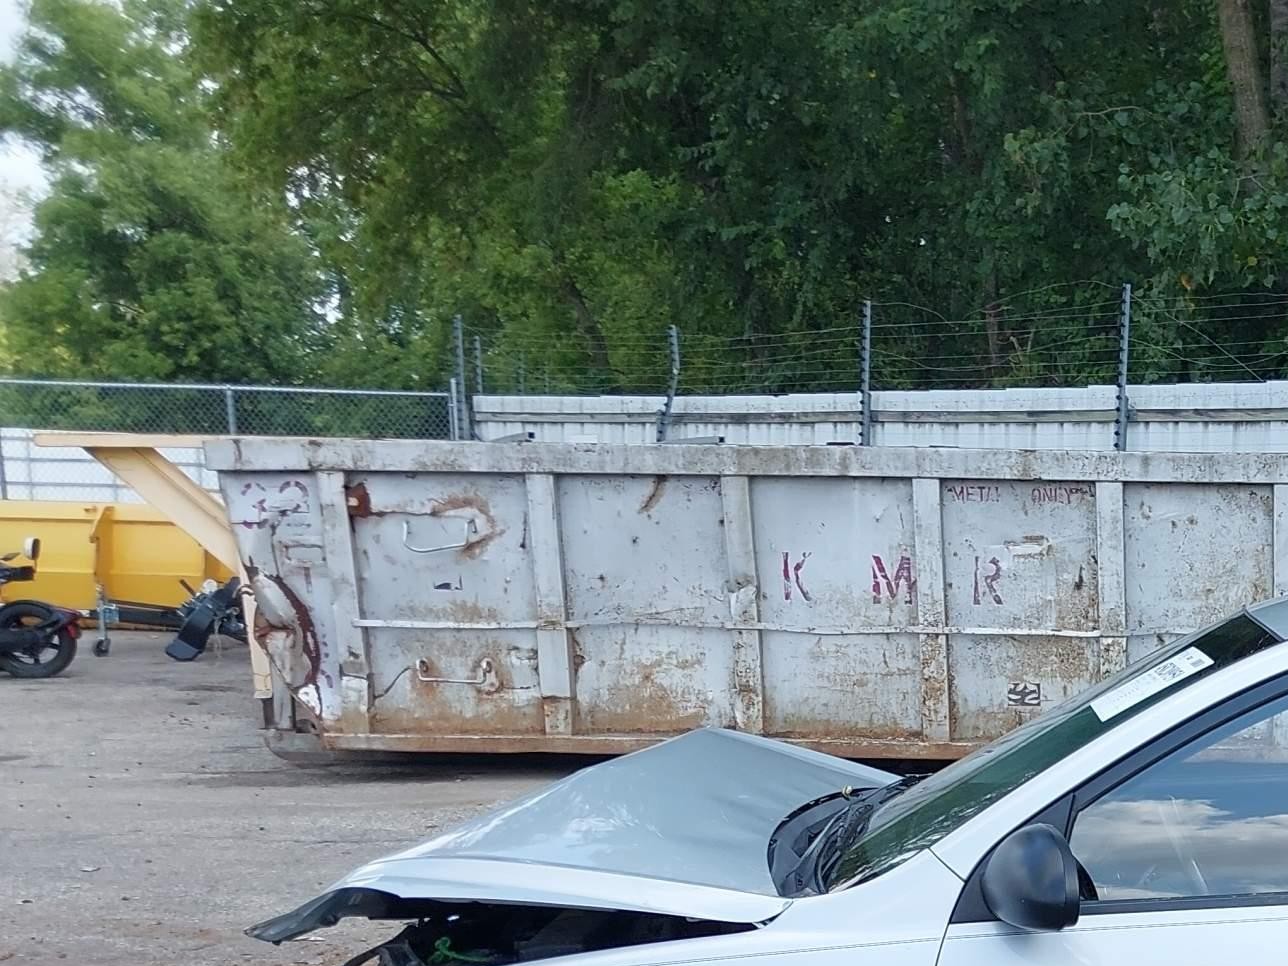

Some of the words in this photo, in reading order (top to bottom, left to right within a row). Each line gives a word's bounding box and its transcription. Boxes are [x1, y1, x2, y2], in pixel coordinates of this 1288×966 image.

[782, 551, 812, 602] K
[871, 554, 918, 605] M
[972, 555, 1004, 606] R
